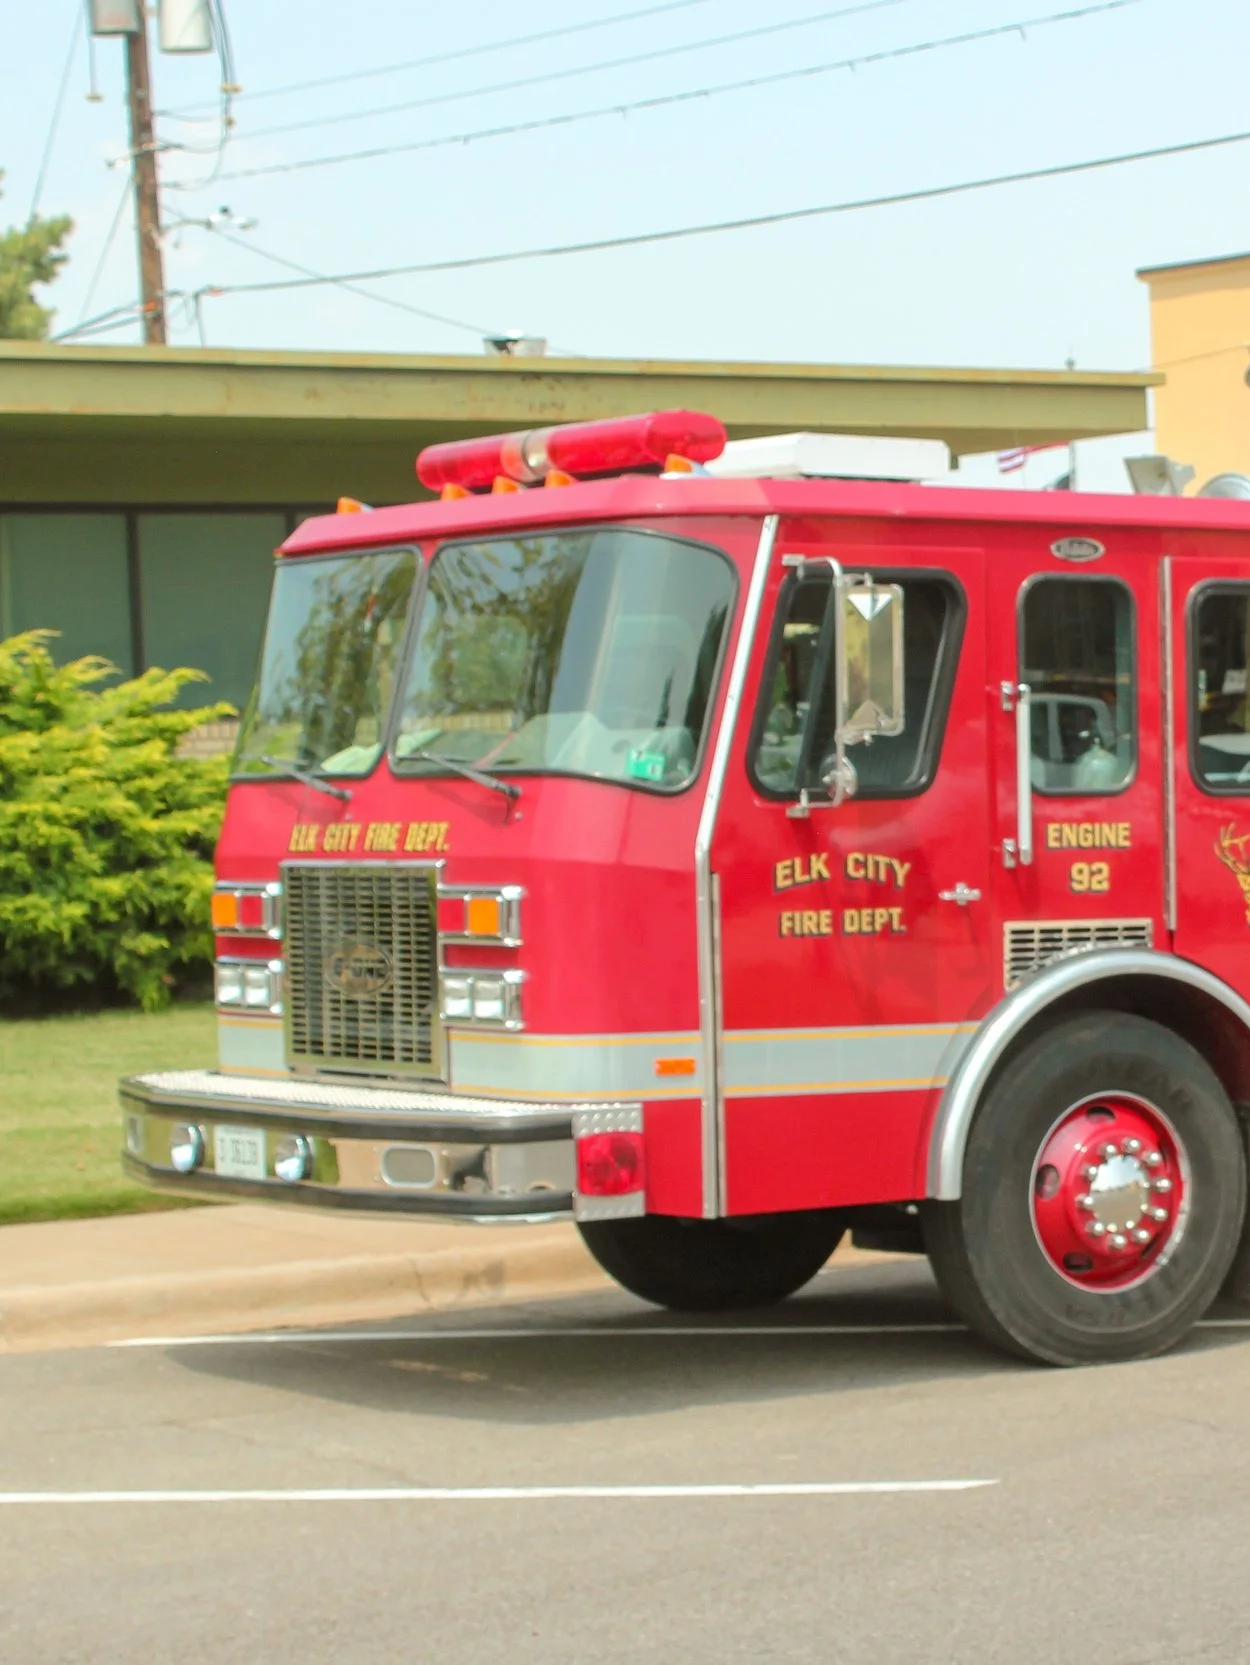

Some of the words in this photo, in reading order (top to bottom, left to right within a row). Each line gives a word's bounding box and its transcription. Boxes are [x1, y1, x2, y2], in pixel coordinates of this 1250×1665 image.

[288, 823, 320, 852] ELK
[322, 822, 362, 852] CITY
[363, 822, 402, 852] FIRE
[403, 820, 450, 852] DEPT.
[1046, 822, 1131, 850] ENGINE
[774, 852, 831, 892] ELK
[845, 852, 911, 888] CITY
[1069, 861, 1110, 894] 92
[779, 909, 833, 938] FIRE
[842, 907, 908, 935] DEPT.
